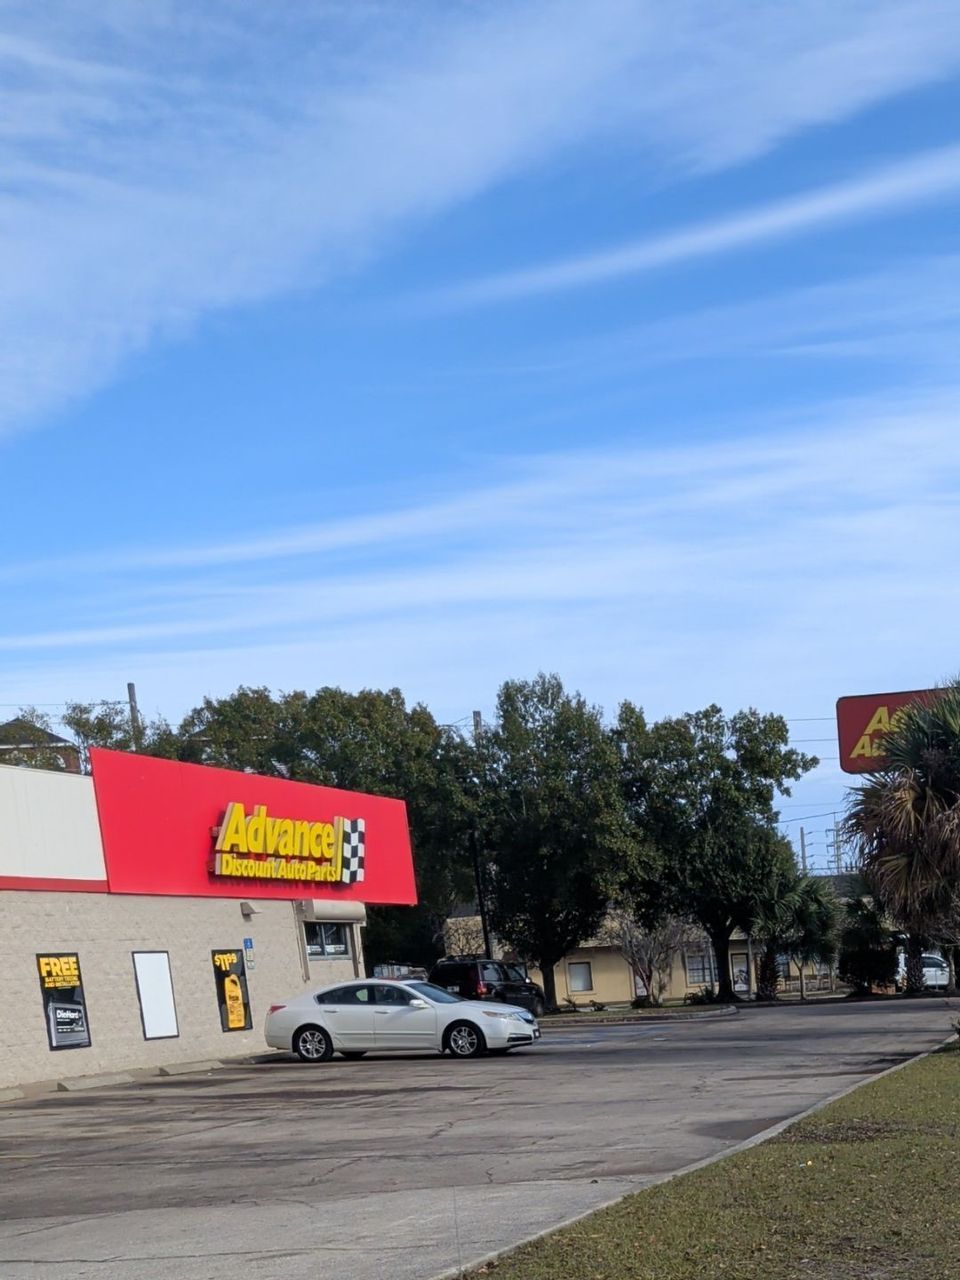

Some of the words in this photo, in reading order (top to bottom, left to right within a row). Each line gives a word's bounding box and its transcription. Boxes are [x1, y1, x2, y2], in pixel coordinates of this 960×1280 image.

[219, 802, 334, 858] Advance
[220, 853, 277, 878] Discount
[277, 857, 307, 881] Auto
[307, 860, 336, 882] Parts
[40, 957, 79, 977] FREE
[57, 1009, 80, 1019] DieHard
